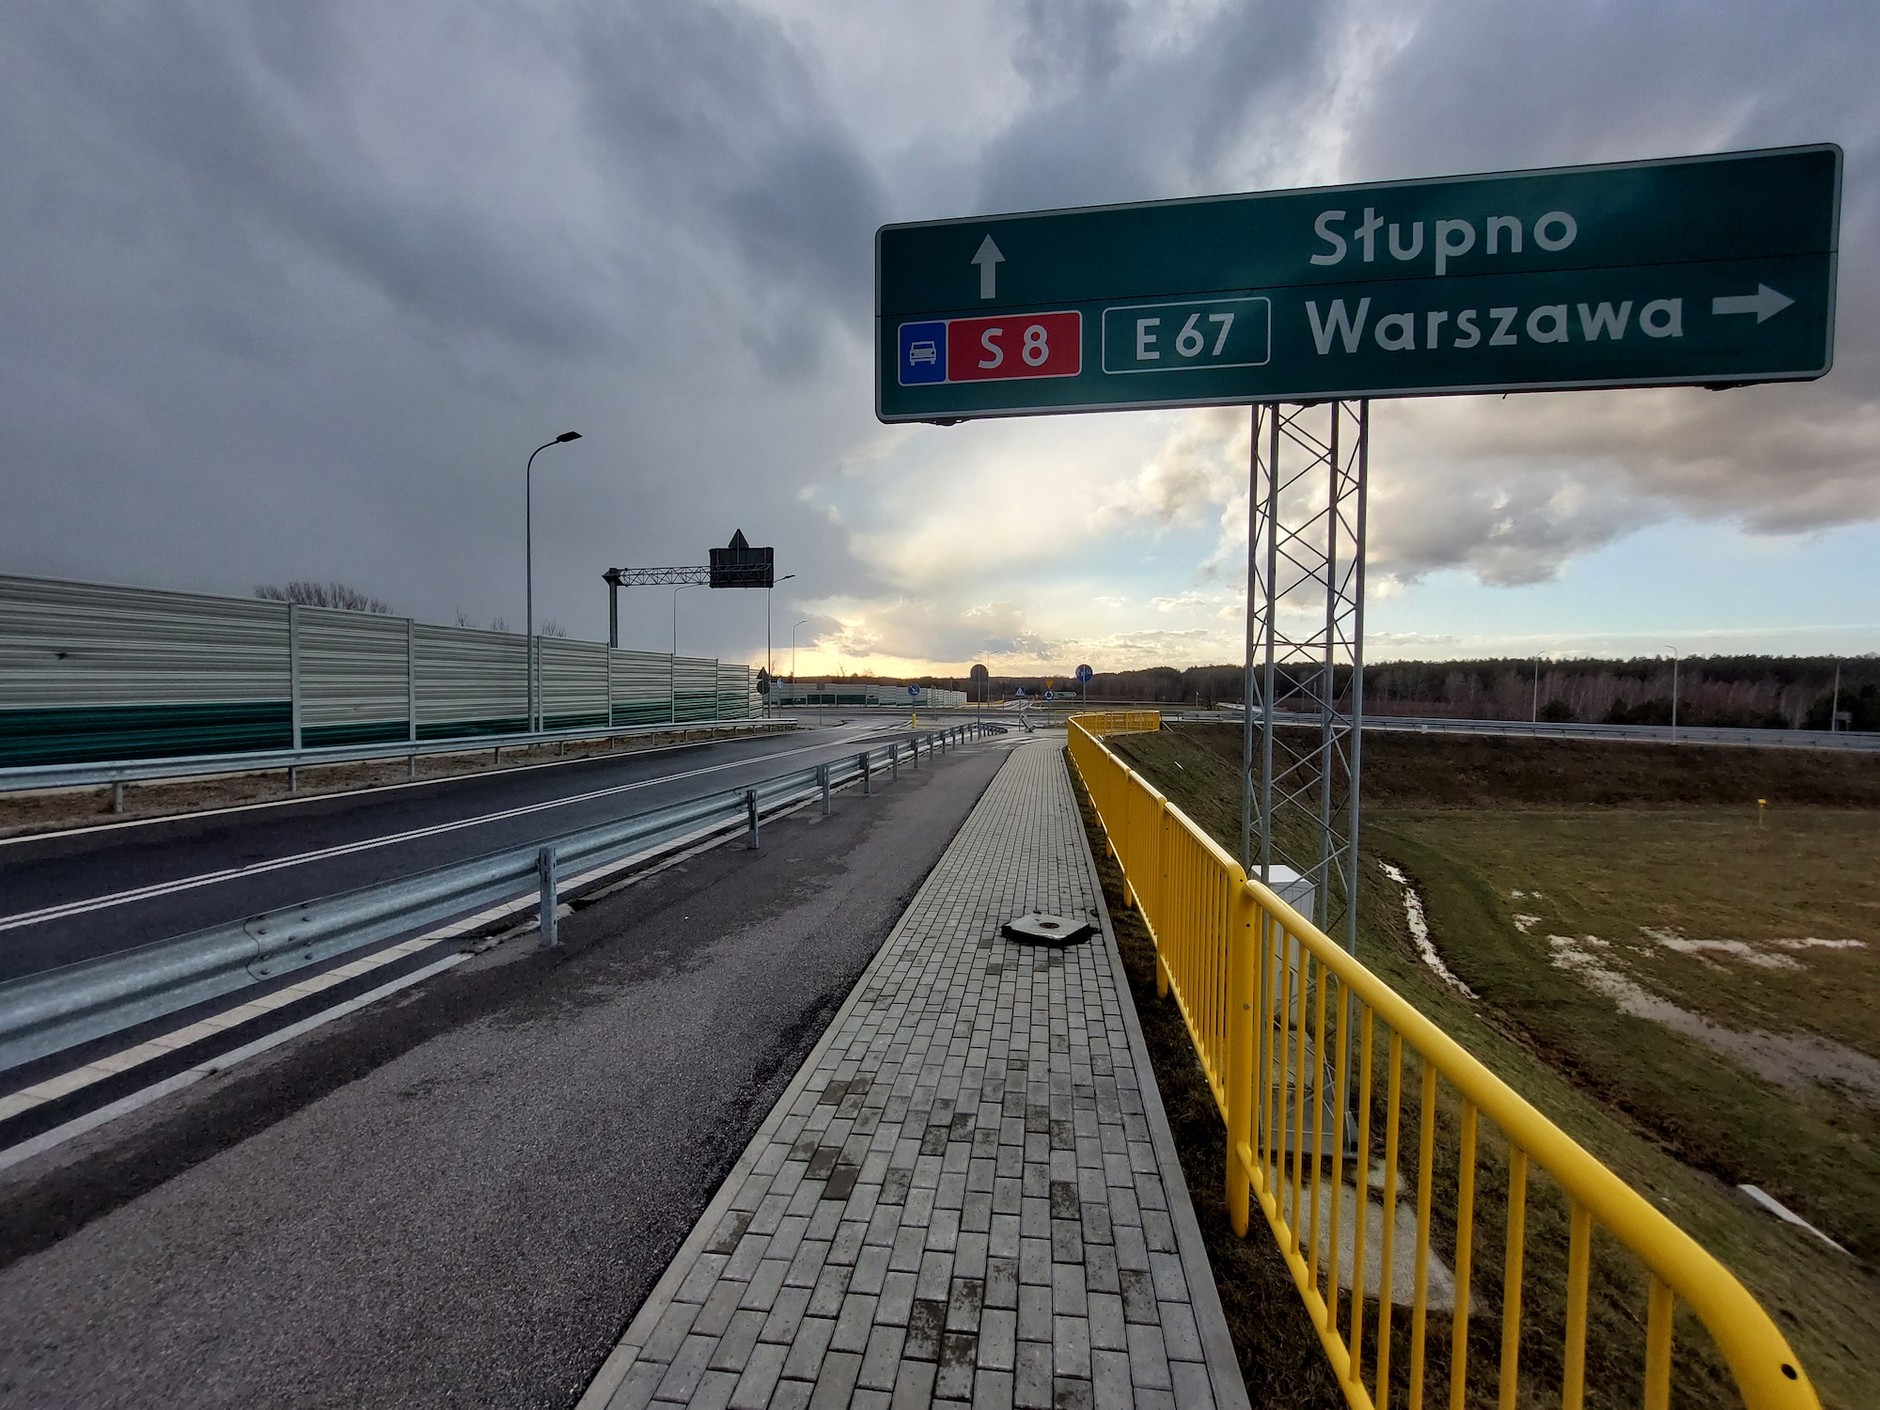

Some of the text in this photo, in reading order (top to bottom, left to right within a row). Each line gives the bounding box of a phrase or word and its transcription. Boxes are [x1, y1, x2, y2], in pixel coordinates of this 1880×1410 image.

[1309, 207, 1578, 276] Słupno
[978, 325, 1050, 369] S 8
[1136, 312, 1235, 361] E 67
[1305, 297, 1684, 355] Warszawa
